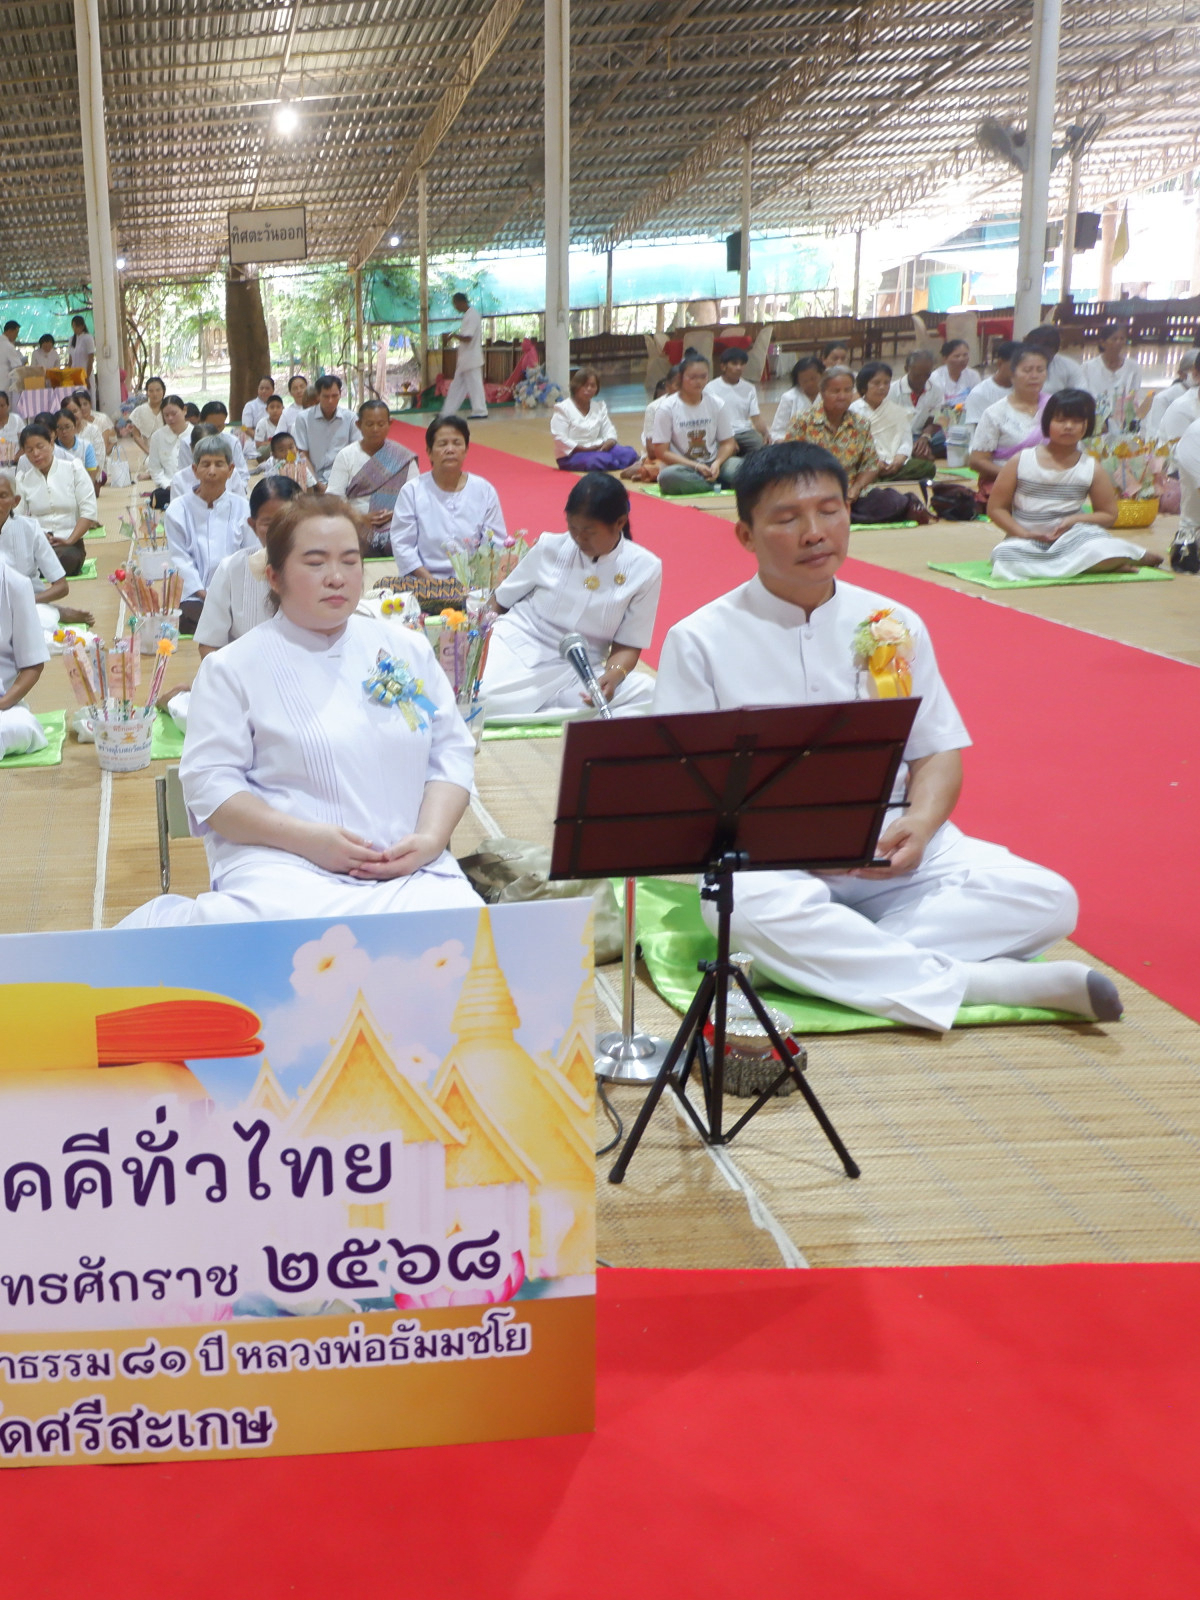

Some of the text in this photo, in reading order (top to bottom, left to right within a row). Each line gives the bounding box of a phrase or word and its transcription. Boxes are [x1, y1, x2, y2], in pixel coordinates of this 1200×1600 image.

[231, 222, 304, 244] ทิศตะวันออก
[262, 1229, 501, 1294] ๒๕๖๘
[122, 1341, 187, 1375] ๘๑
[199, 1334, 225, 1372] ปี
[236, 1311, 528, 1370] หลวงพ่อธัมมชโย
